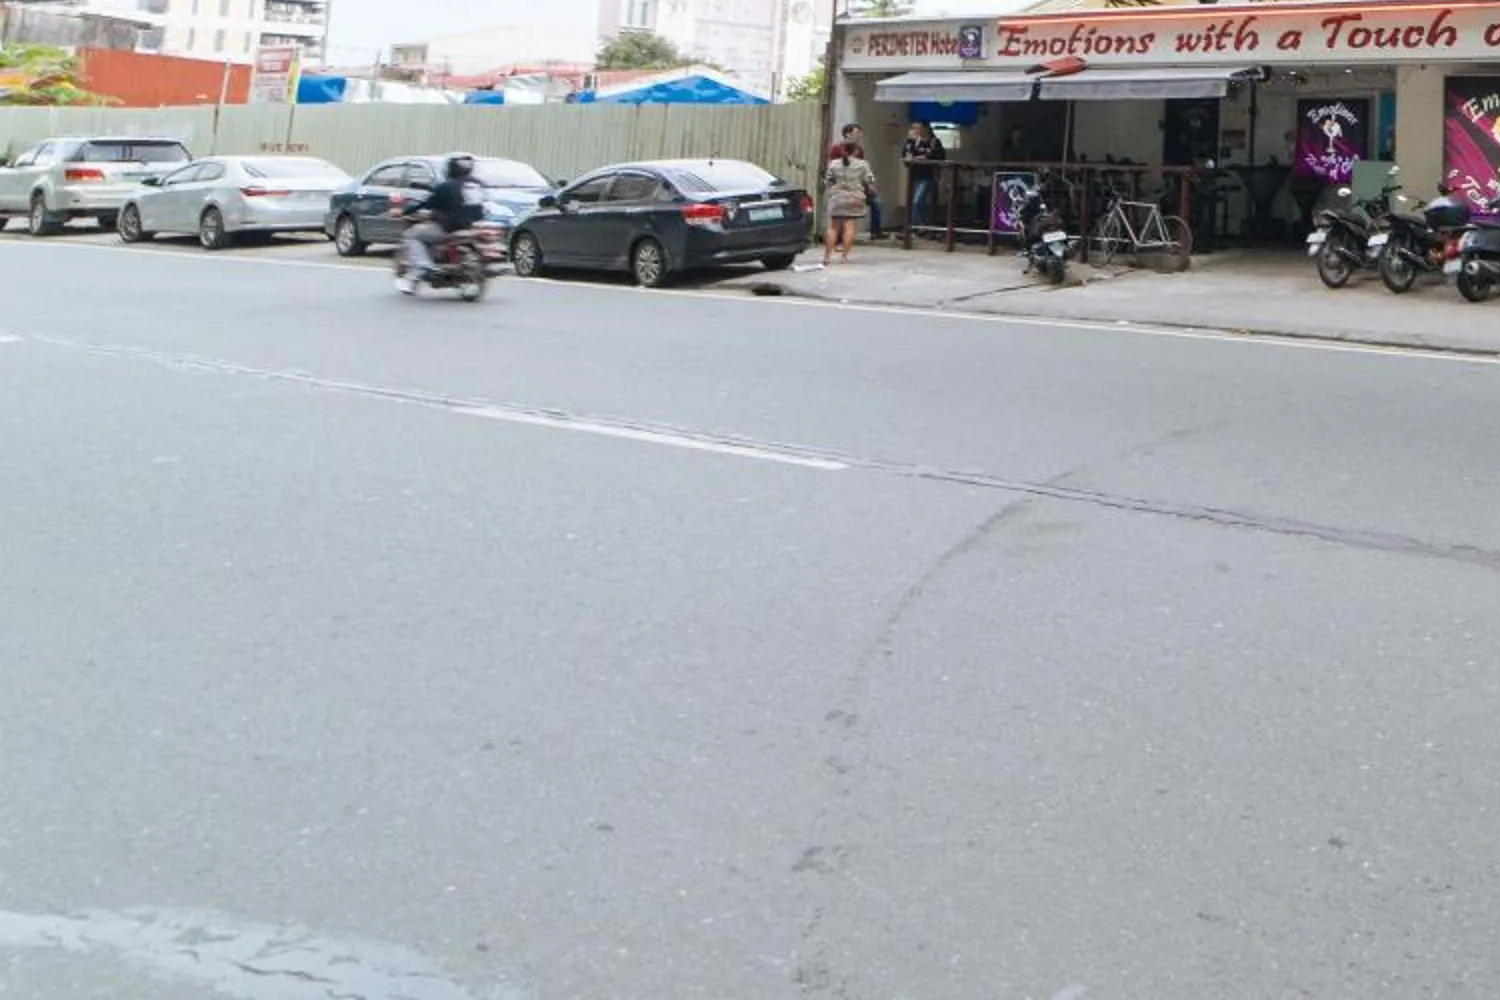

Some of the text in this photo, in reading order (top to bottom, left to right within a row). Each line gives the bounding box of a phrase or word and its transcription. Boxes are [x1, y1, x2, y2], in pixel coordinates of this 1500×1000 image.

[868, 31, 929, 57] PERIMETER
[930, 31, 960, 56] Hote
[996, 23, 1154, 56] Emotions
[1175, 15, 1259, 53] with
[1276, 30, 1301, 50] a
[1321, 8, 1458, 49] Touch
